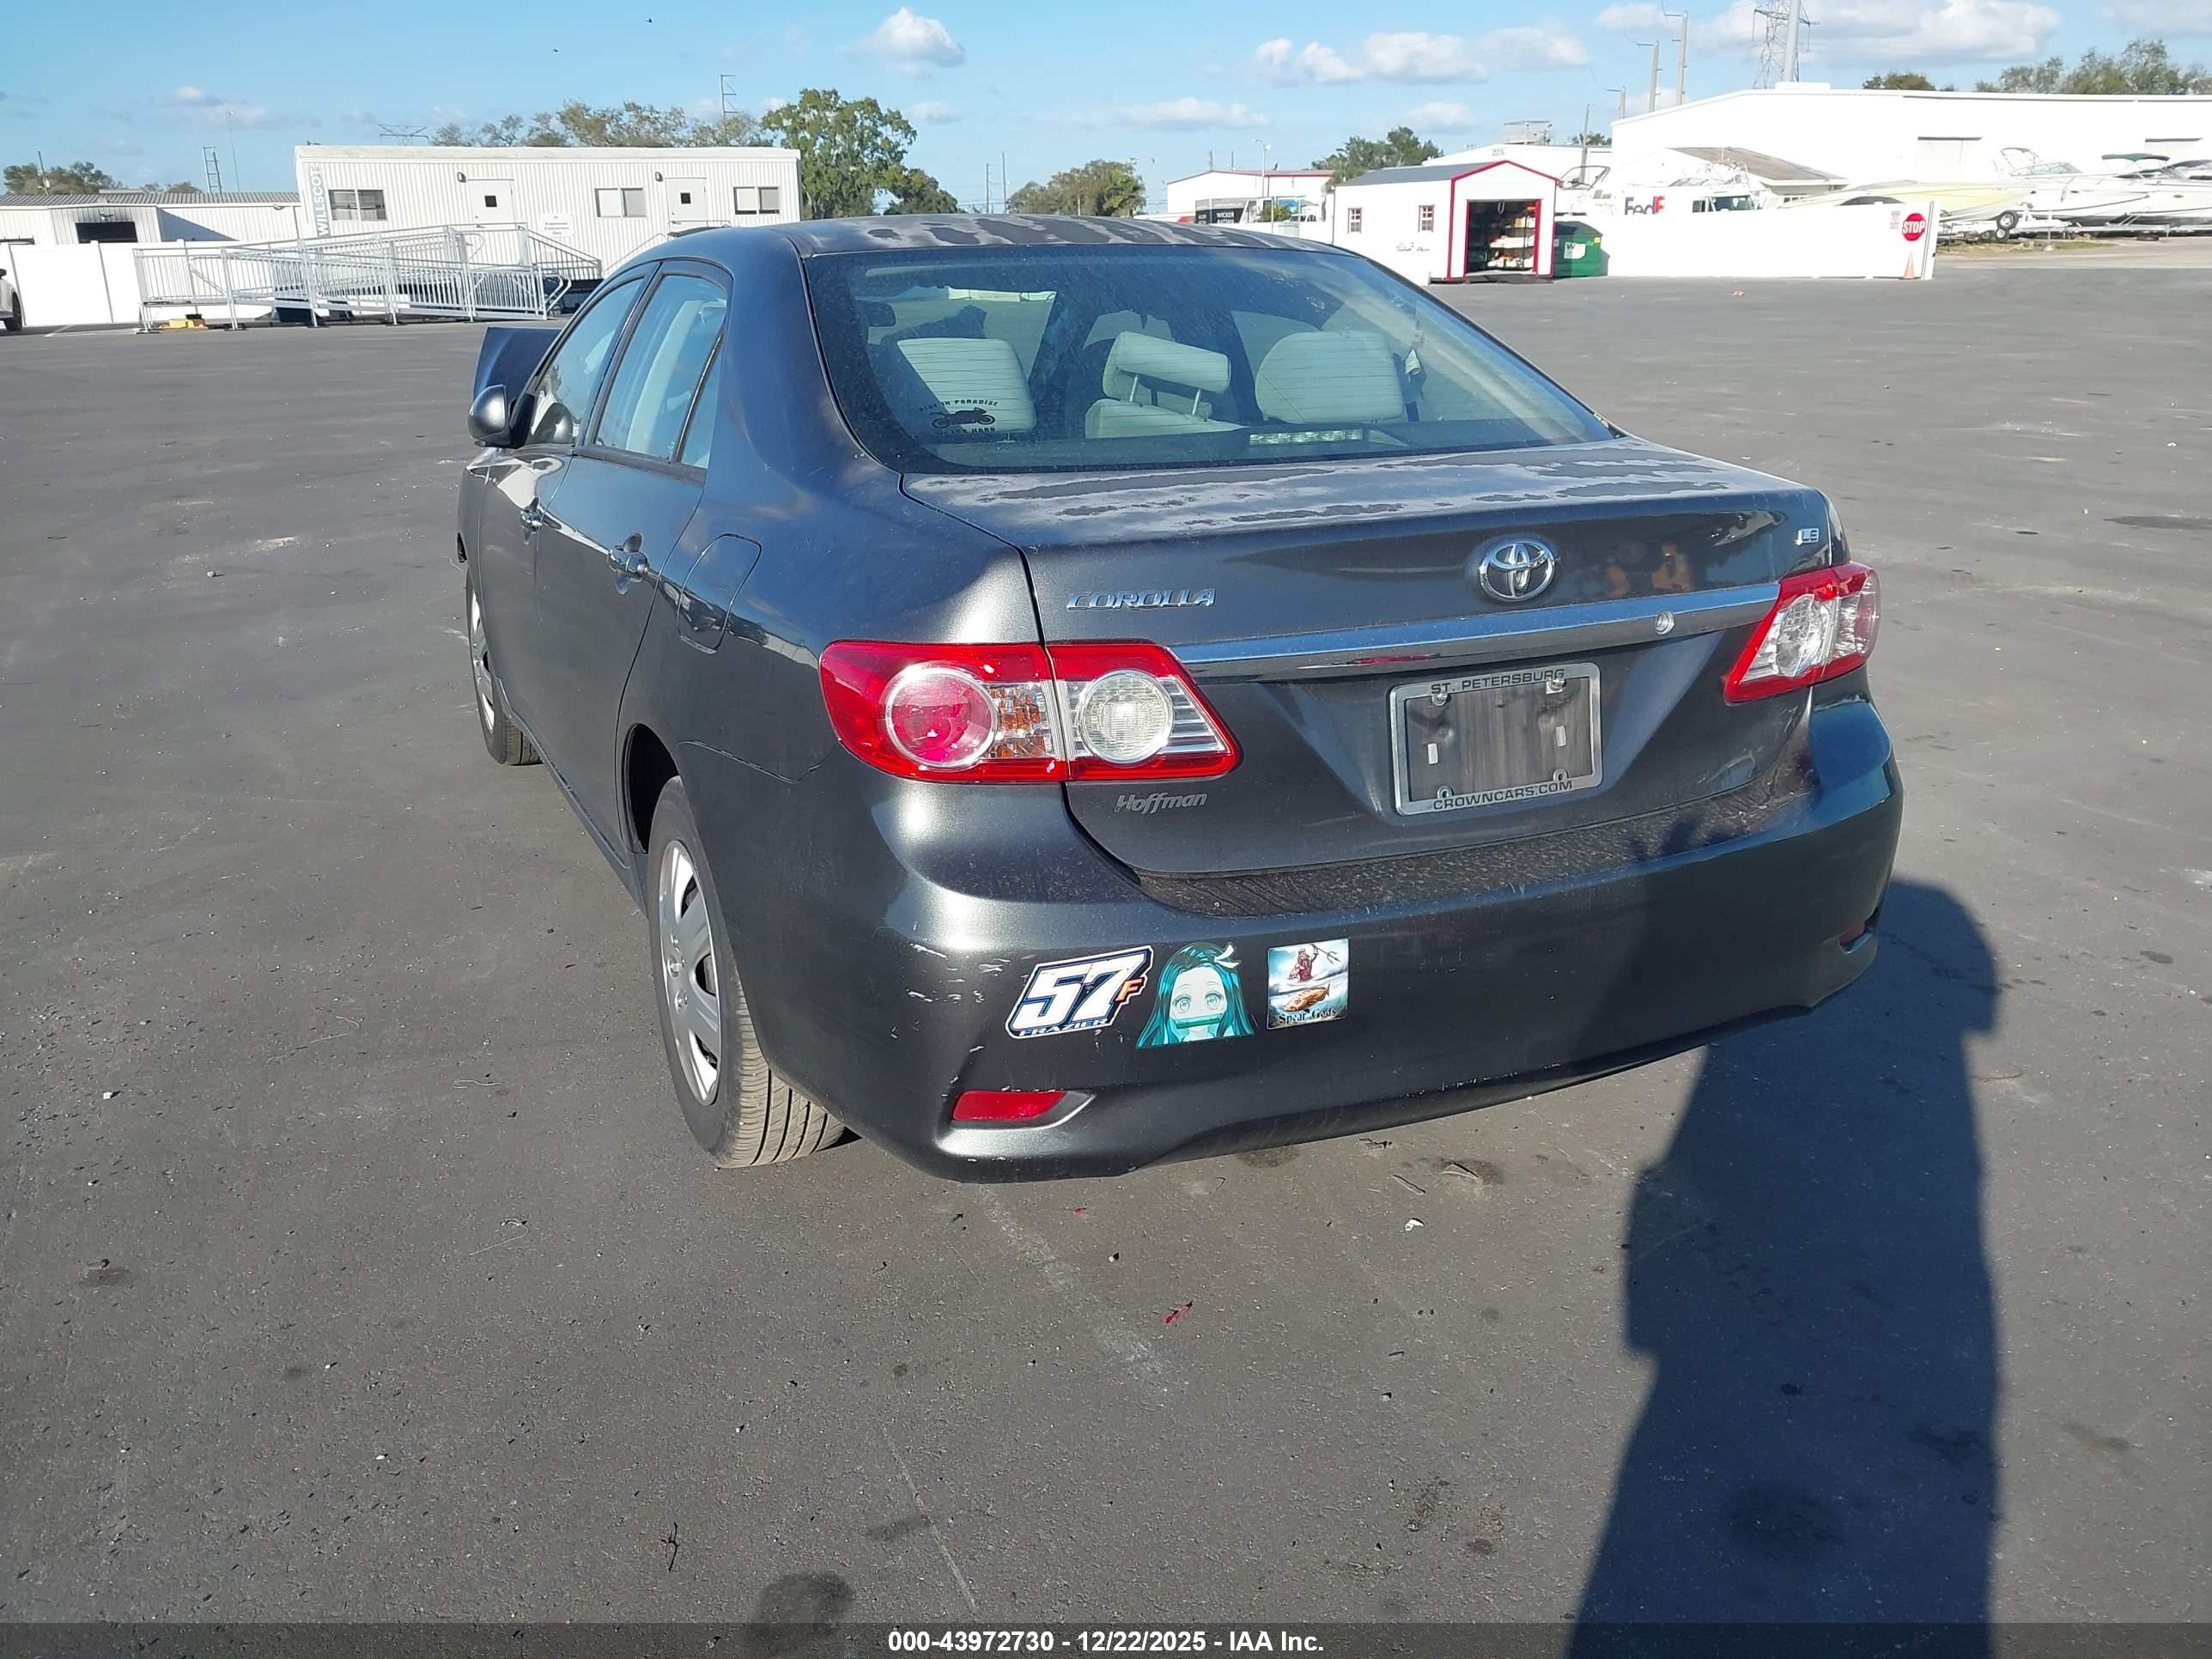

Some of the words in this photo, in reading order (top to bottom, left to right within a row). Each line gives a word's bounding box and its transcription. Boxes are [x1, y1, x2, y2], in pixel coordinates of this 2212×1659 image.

[1903, 221, 1926, 234] STOP
[1066, 588, 1217, 611] COROLLA
[1431, 683, 1456, 695] ST.
[1462, 668, 1566, 690] PETERSBURG
[1114, 792, 1208, 815] Hoffman
[1433, 781, 1573, 810] CROWNCARS.COM
[1011, 951, 1147, 1030] 57
[1278, 1012, 1307, 1024] Spear
[1312, 1006, 1337, 1019] Gods
[1018, 1018, 1109, 1037] FRAZIER
